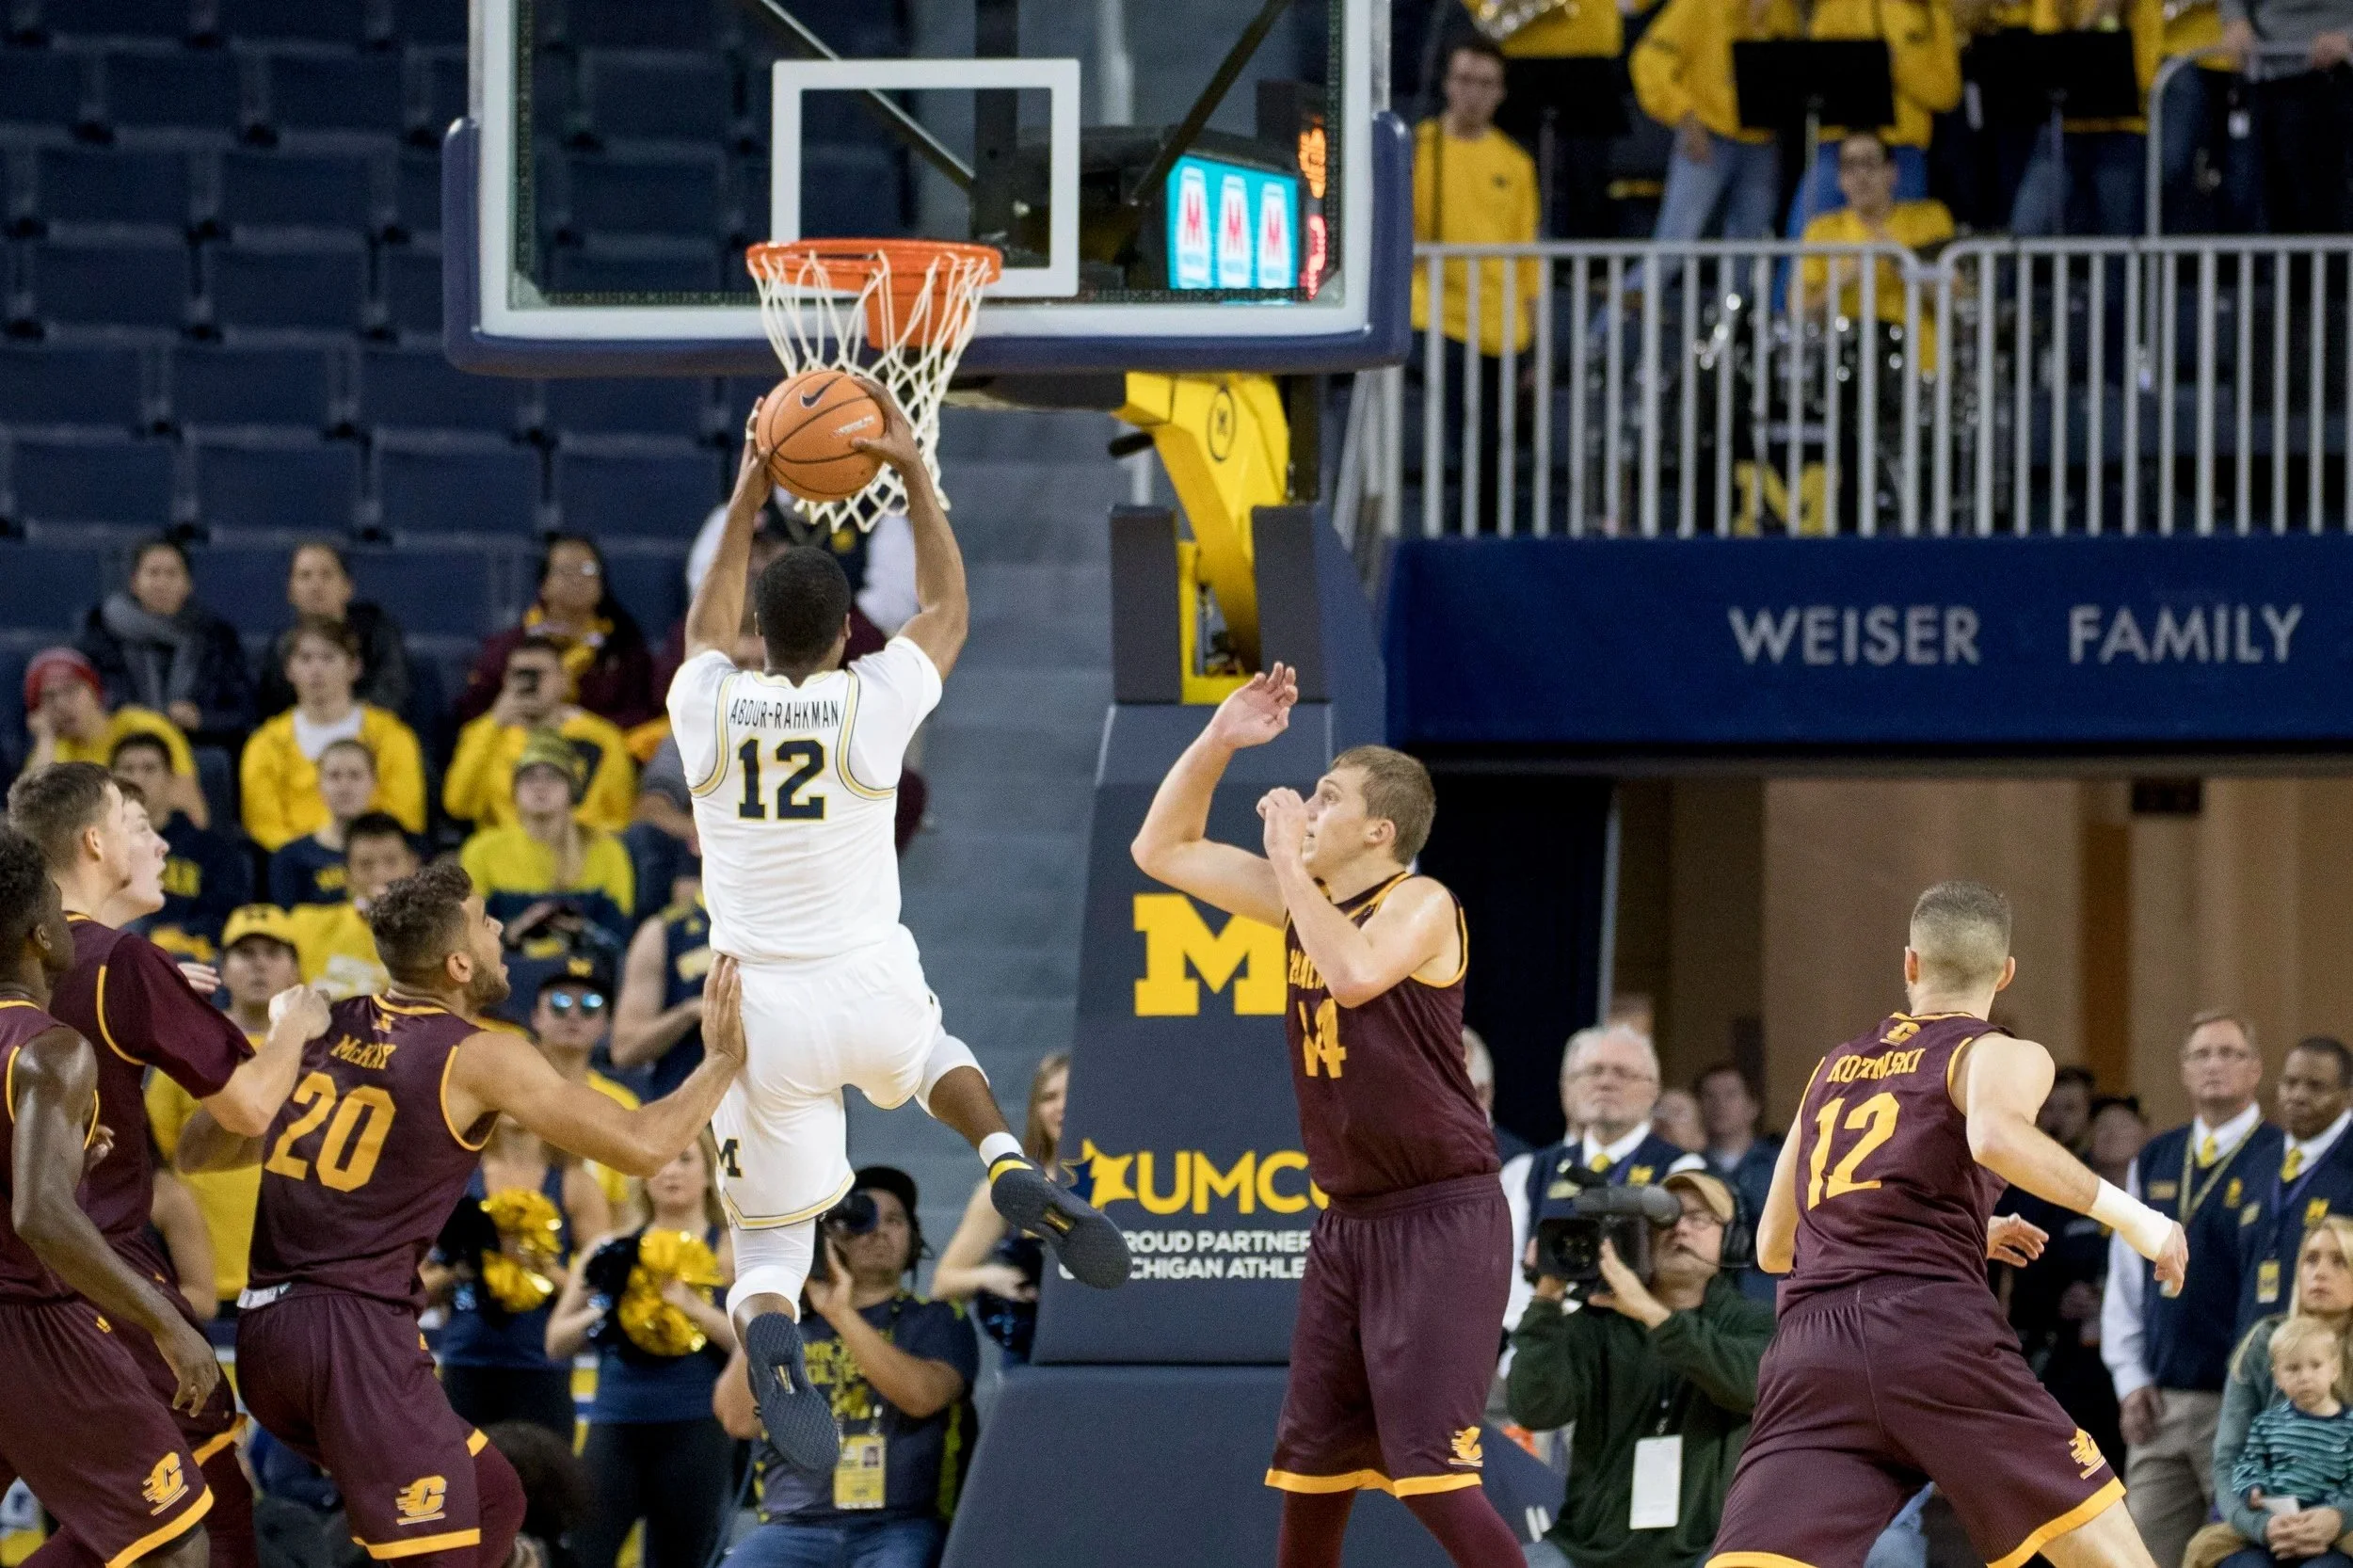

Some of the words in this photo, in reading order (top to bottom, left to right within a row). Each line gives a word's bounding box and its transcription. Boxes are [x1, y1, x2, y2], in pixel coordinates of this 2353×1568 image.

[1727, 604, 1980, 665] WEISER
[2069, 603, 2303, 664] FAMILY
[729, 698, 839, 729] ABDUR-RAHKMAN
[738, 737, 825, 821] 12
[1133, 893, 1287, 1016] M
[1298, 998, 1347, 1079] 14
[1826, 1048, 1926, 1082] KOZNSKI
[264, 1071, 396, 1192] 20
[1808, 1092, 1900, 1210] 12
[1136, 1149, 1330, 1214] UMC
[1122, 1229, 1194, 1254] ROUD
[1129, 1256, 1224, 1279] CHIGAN
[1225, 1256, 1307, 1279] ATHLE
[395, 1475, 447, 1517] C
